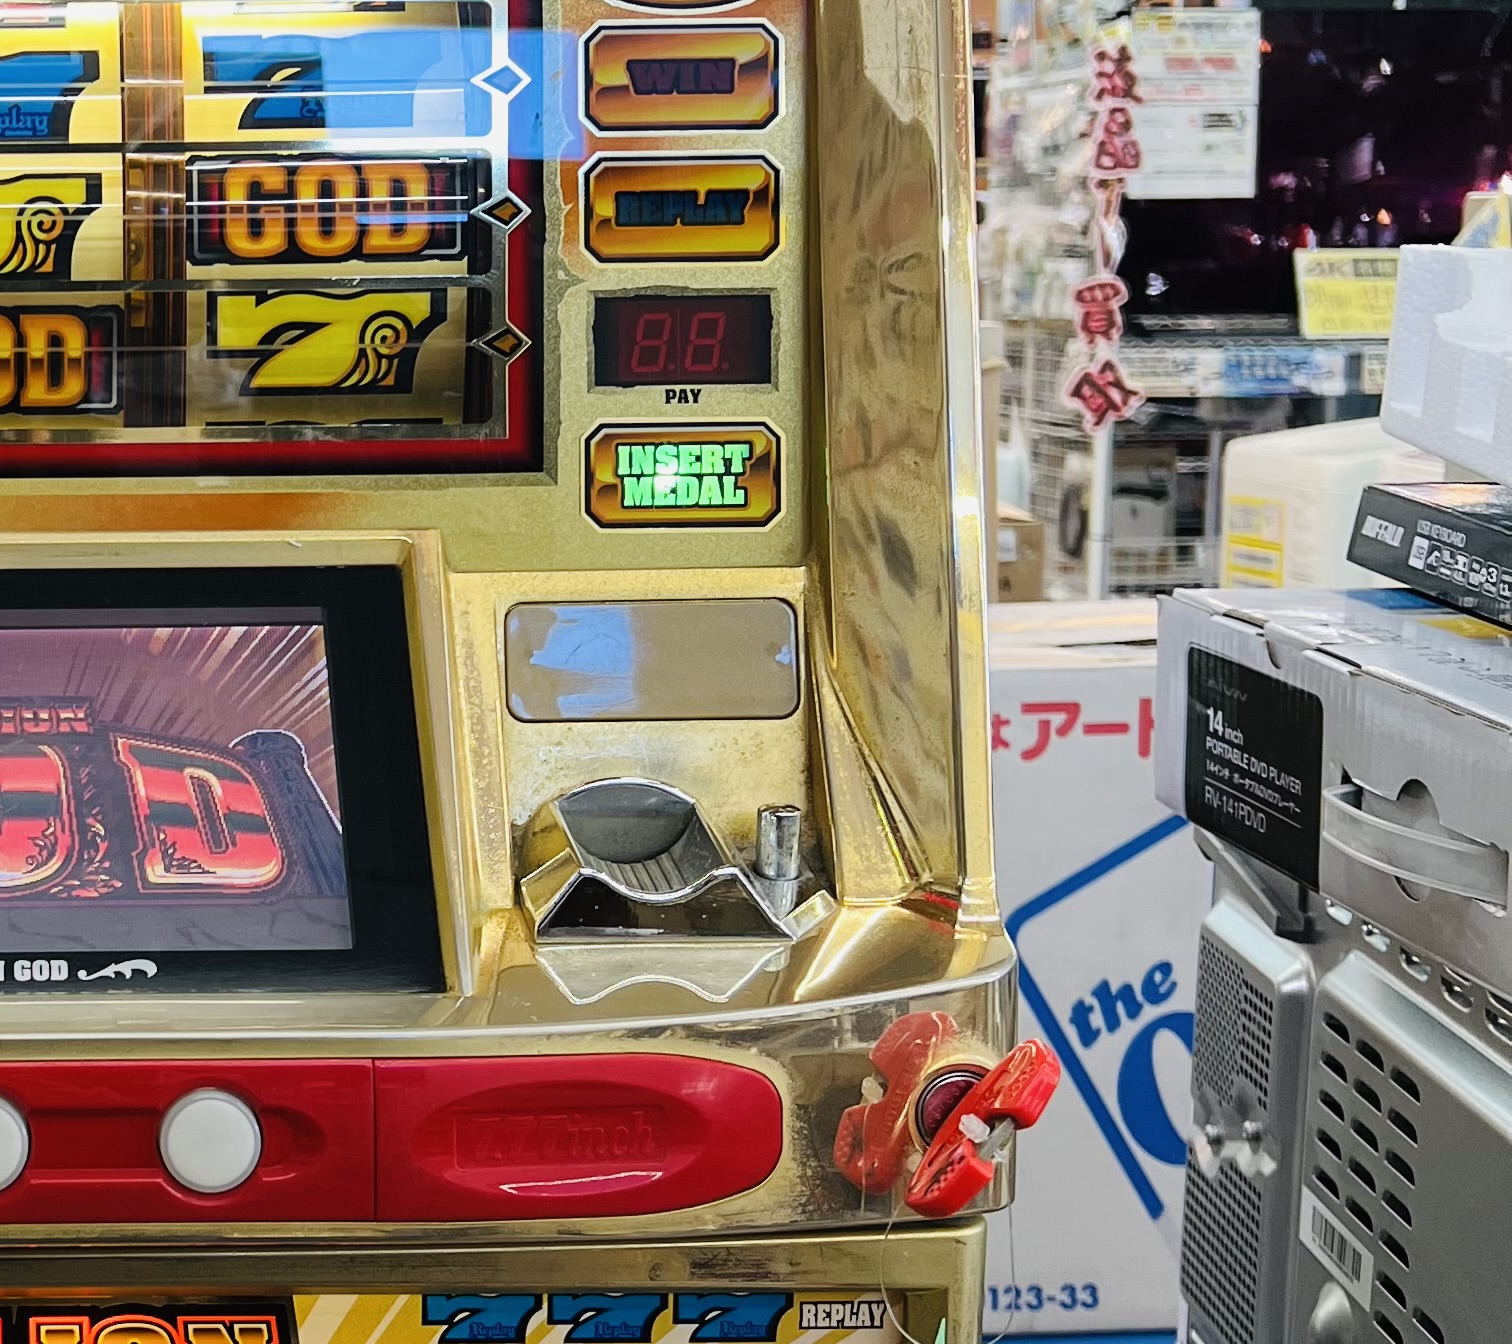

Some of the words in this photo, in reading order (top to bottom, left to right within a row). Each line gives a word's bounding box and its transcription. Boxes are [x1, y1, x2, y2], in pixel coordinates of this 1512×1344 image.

[627, 60, 735, 94] WIN
[222, 159, 431, 258] GOD
[617, 192, 750, 225] REPLAY
[207, 289, 448, 395] 7
[664, 389, 702, 405] PAY
[617, 444, 751, 476] INSERT
[624, 476, 746, 507] MEDAL
[1206, 736, 1249, 770] PORTABLE
[1250, 761, 1268, 778] DVD
[1269, 766, 1302, 796] PLAYER
[1204, 785, 1267, 833] RV-141PDVD
[14, 960, 70, 984] GOD
[1069, 959, 1177, 1049] the
[800, 1301, 887, 1329] REPLAY
